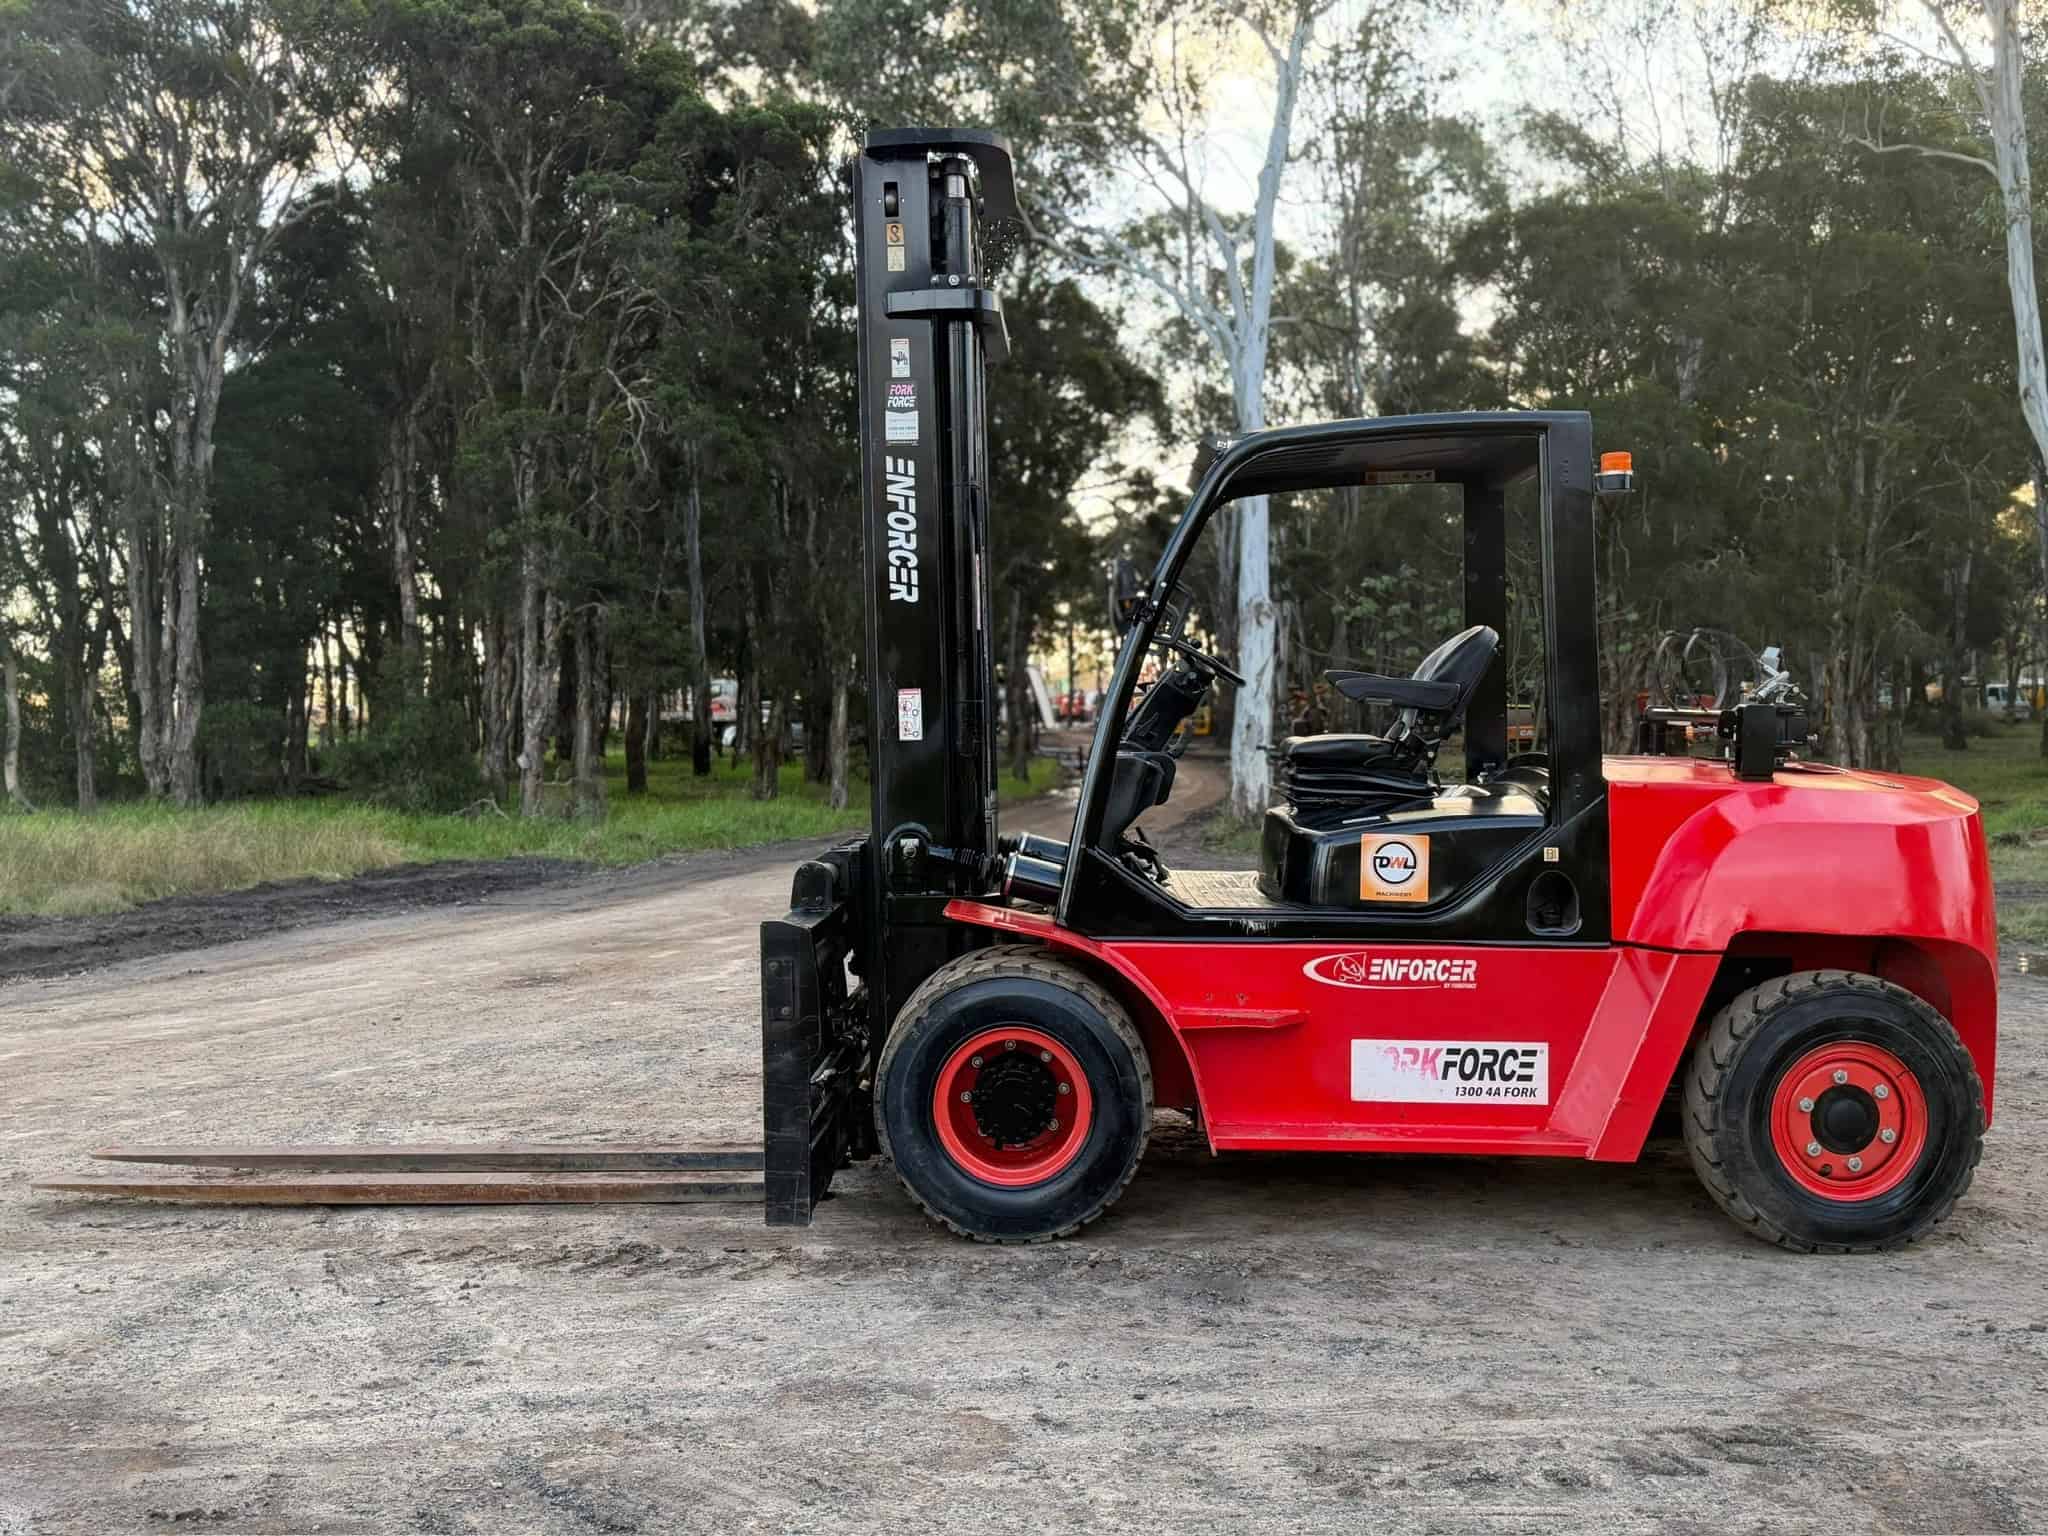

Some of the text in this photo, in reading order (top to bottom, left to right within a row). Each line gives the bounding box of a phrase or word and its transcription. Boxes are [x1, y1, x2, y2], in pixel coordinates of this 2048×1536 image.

[889, 384, 913, 396] FORK
[888, 396, 917, 408] FORCE
[885, 455, 919, 604] ENFORCER
[1375, 856, 1416, 869] DWL
[1369, 958, 1478, 982] ENFORCER
[1455, 1086, 1538, 1098] 1300 4A FORK
